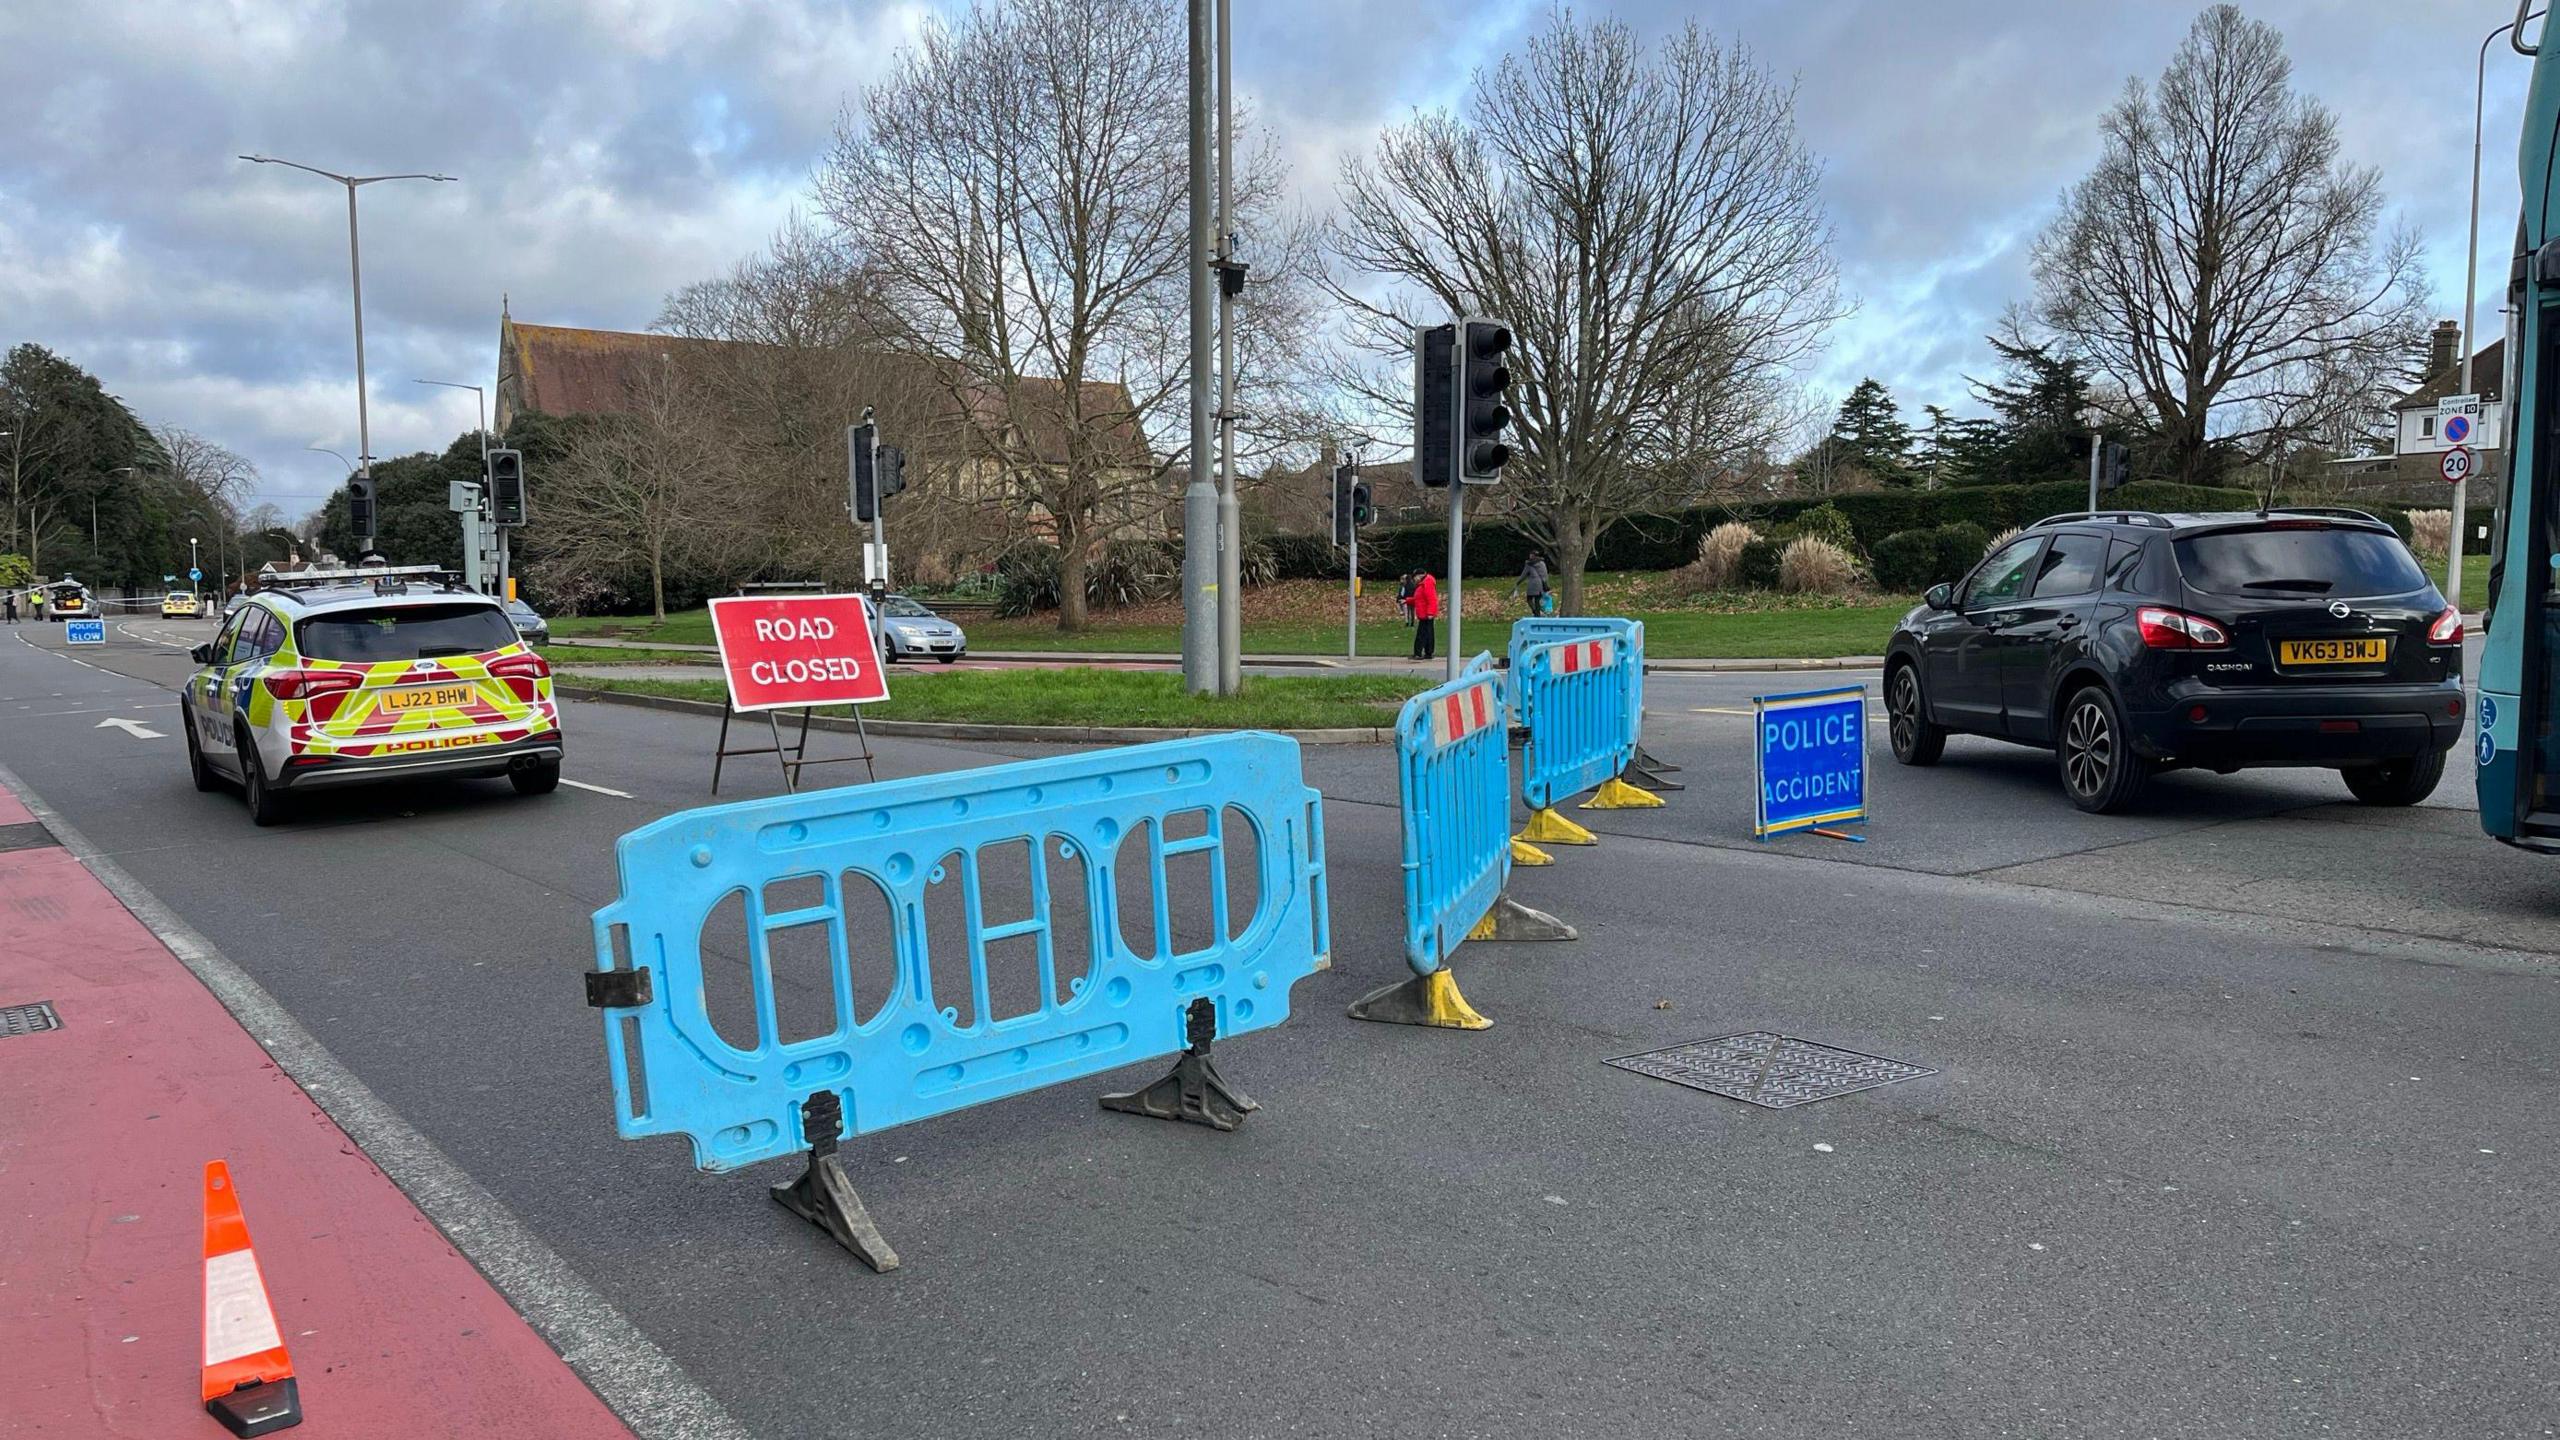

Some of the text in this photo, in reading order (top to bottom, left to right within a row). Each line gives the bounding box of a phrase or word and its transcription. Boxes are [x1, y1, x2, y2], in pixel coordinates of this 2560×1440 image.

[2440, 405, 2476, 415] ZONE 10
[2442, 397, 2476, 405] Controlled
[2445, 457, 2467, 472] 20
[71, 632, 101, 641] SLOW
[754, 617, 835, 642] ROAD
[2291, 641, 2378, 660] VK63 BWJ
[751, 657, 860, 685] CLOSED
[2207, 663, 2253, 672] QASHQAI
[389, 688, 468, 709] LJ22 BHW
[1765, 713, 1856, 753] POLICE
[386, 735, 488, 752] POLICE
[1764, 769, 1861, 805] ACCIDENT
